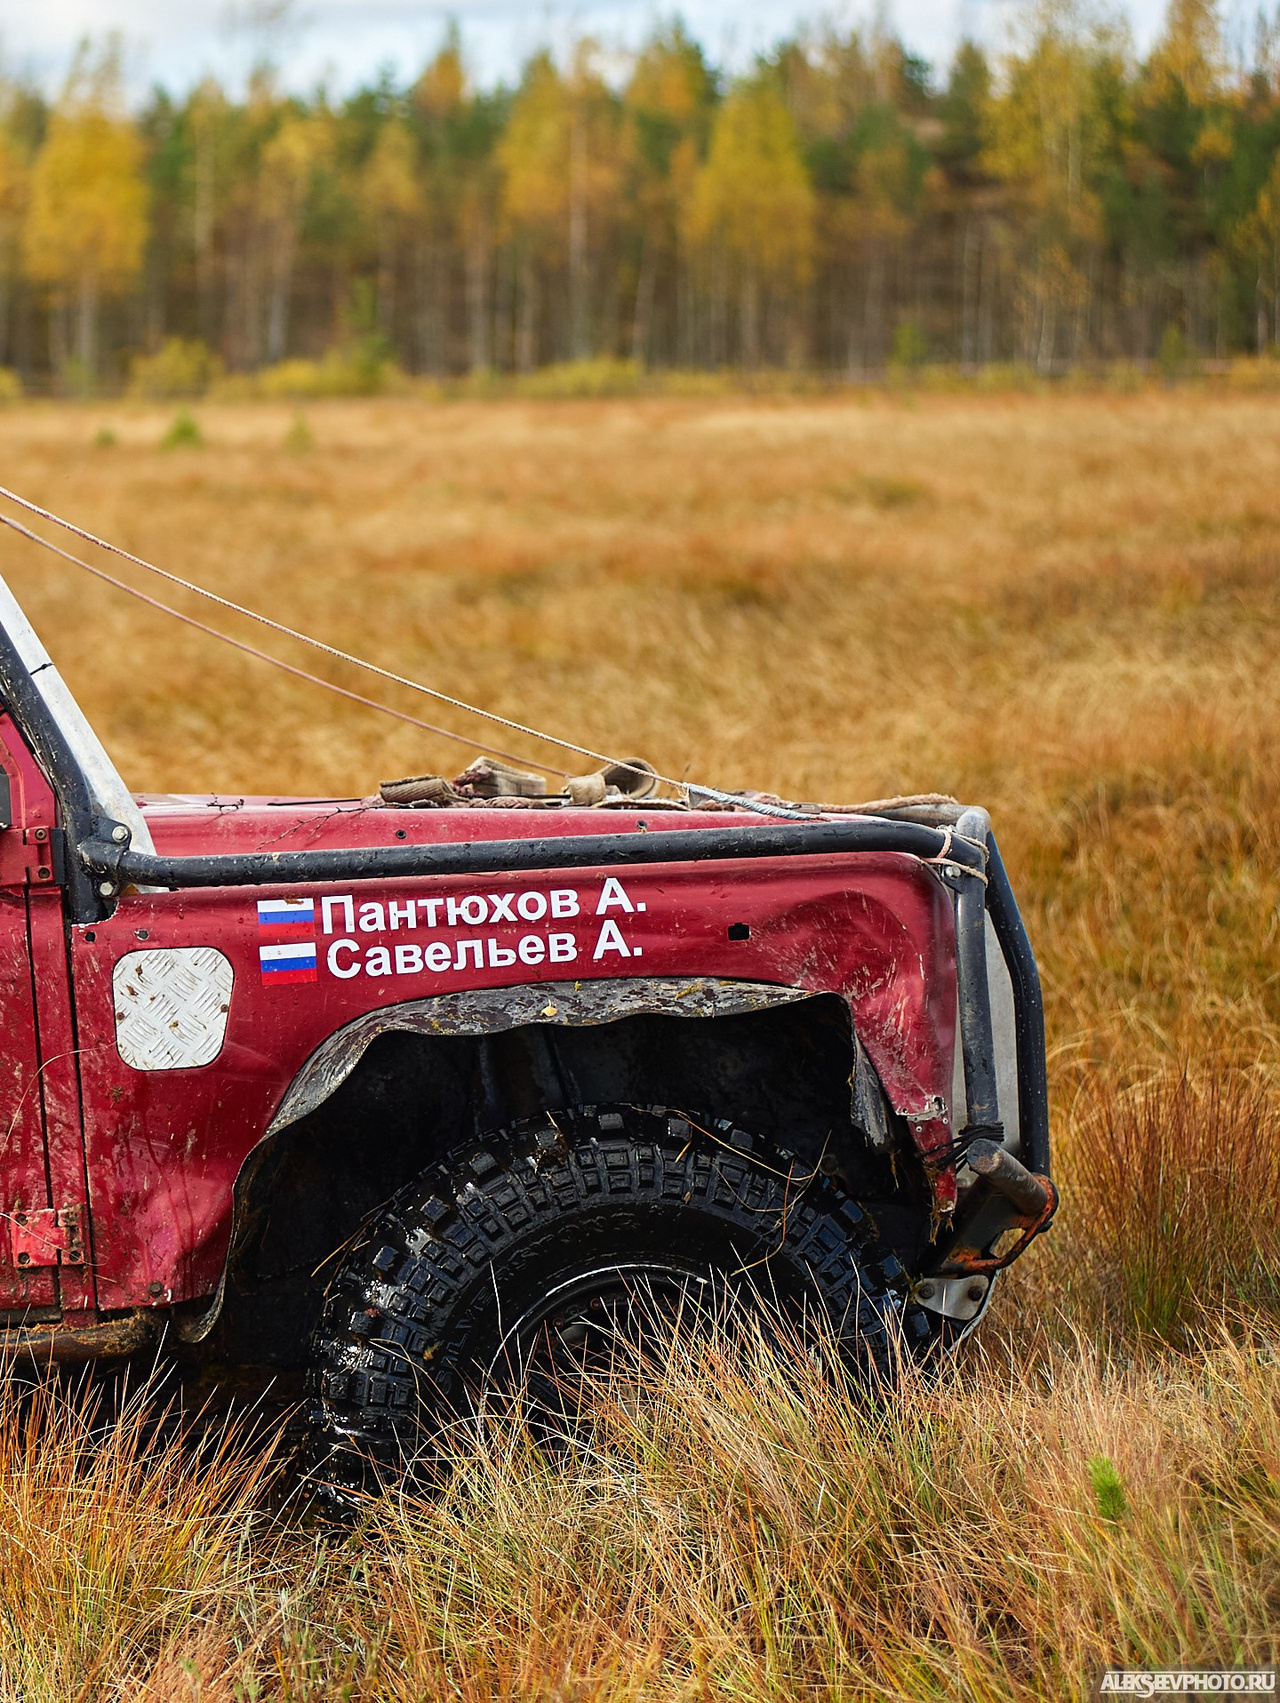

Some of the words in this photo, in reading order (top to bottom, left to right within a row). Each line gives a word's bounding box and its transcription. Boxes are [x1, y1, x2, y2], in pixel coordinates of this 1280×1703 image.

[321, 888, 579, 935] Пантюхов
[595, 877, 647, 916] А.
[326, 931, 578, 980] Савельев
[592, 919, 643, 960] А.
